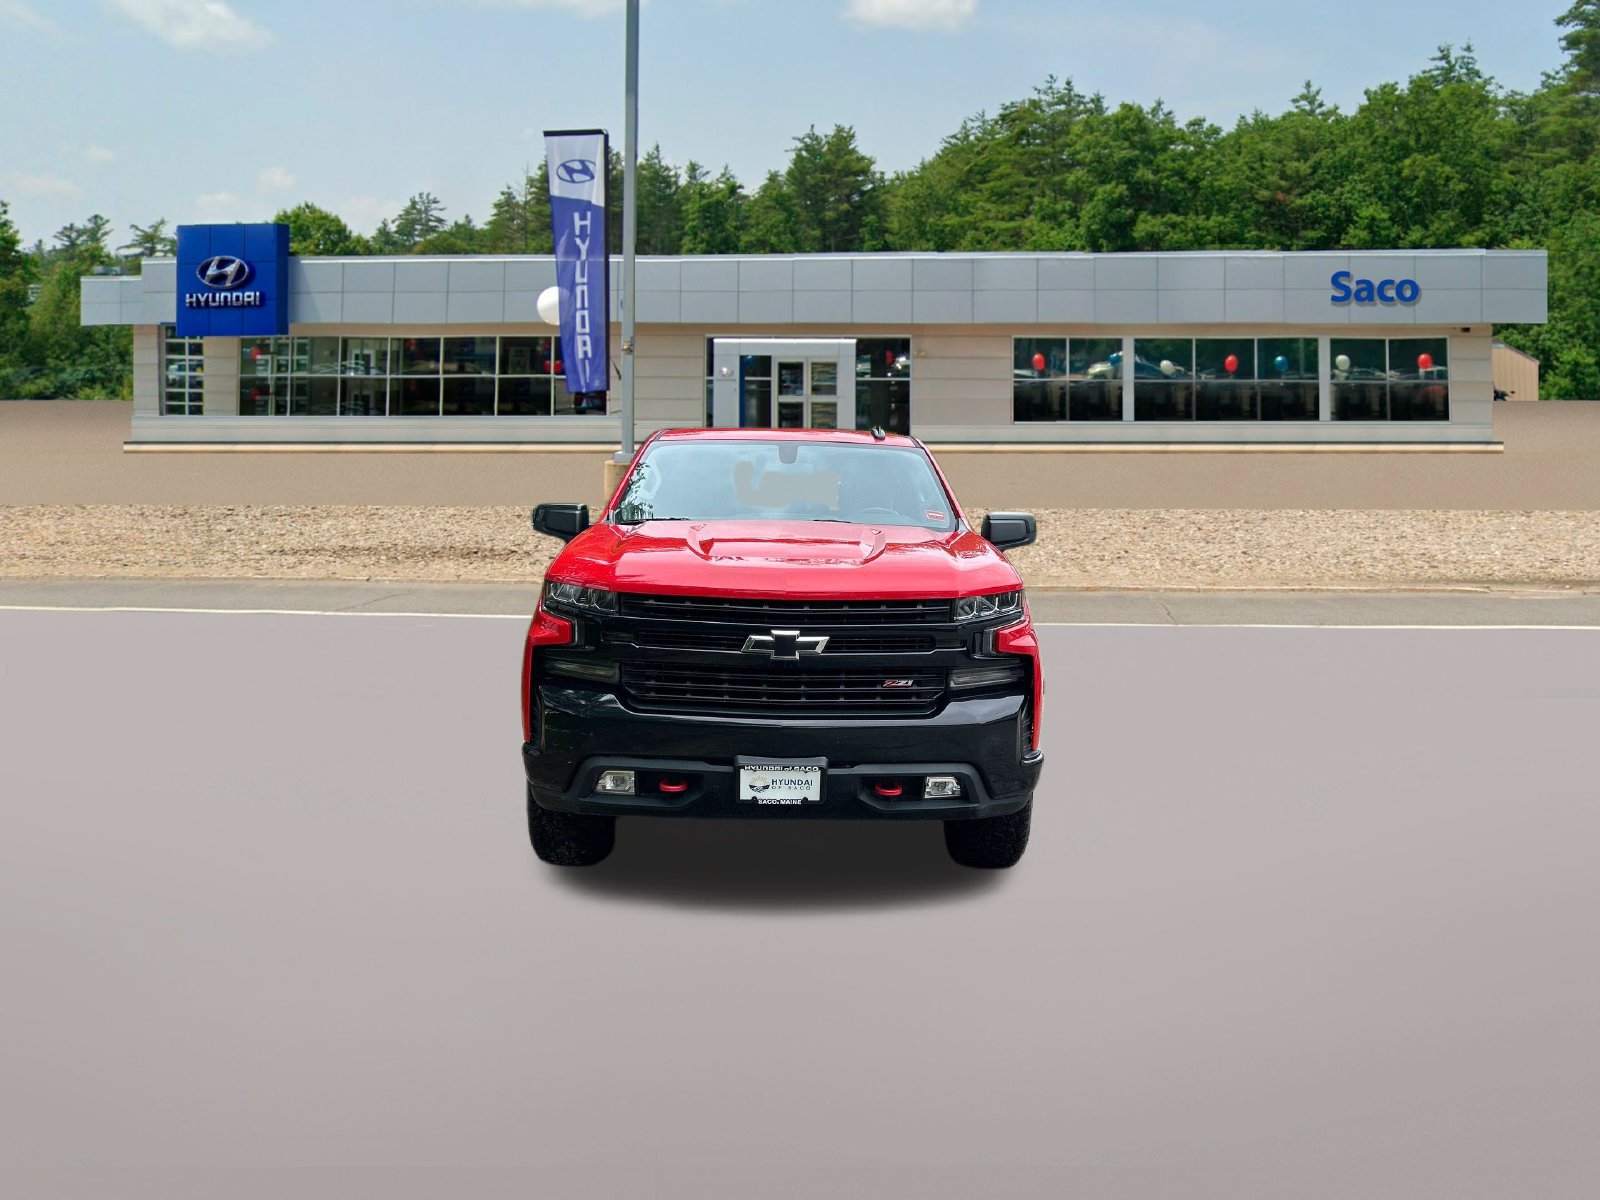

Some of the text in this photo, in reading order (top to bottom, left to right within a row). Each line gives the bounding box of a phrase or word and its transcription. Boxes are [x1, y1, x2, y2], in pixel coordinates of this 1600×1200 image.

[185, 291, 260, 307] HYUNDAI
[573, 211, 592, 383] HYUNDAI
[1330, 270, 1420, 303] Saco
